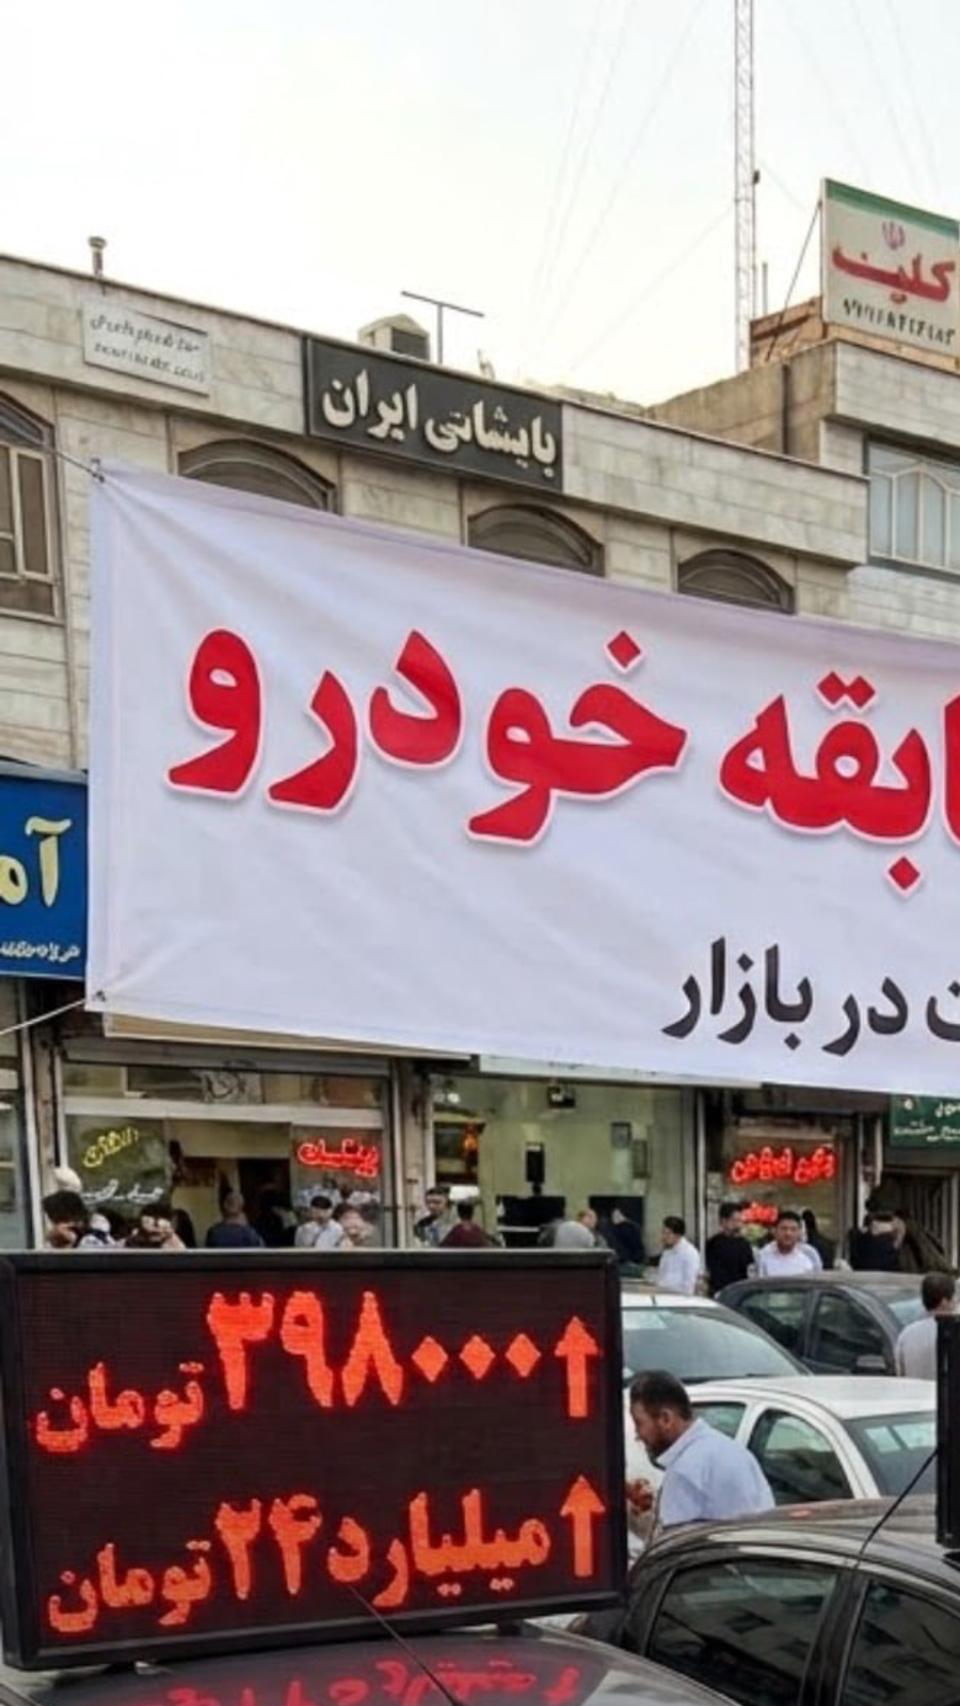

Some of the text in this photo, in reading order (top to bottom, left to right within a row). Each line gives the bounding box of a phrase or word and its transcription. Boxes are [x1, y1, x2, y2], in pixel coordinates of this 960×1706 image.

[322, 368, 420, 442] ایران
[166, 628, 687, 842] خودرو
[661, 936, 814, 1051] بازار
[821, 976, 910, 1057] در
[36, 1361, 205, 1453] تومان
[49, 1539, 212, 1634] تومان
